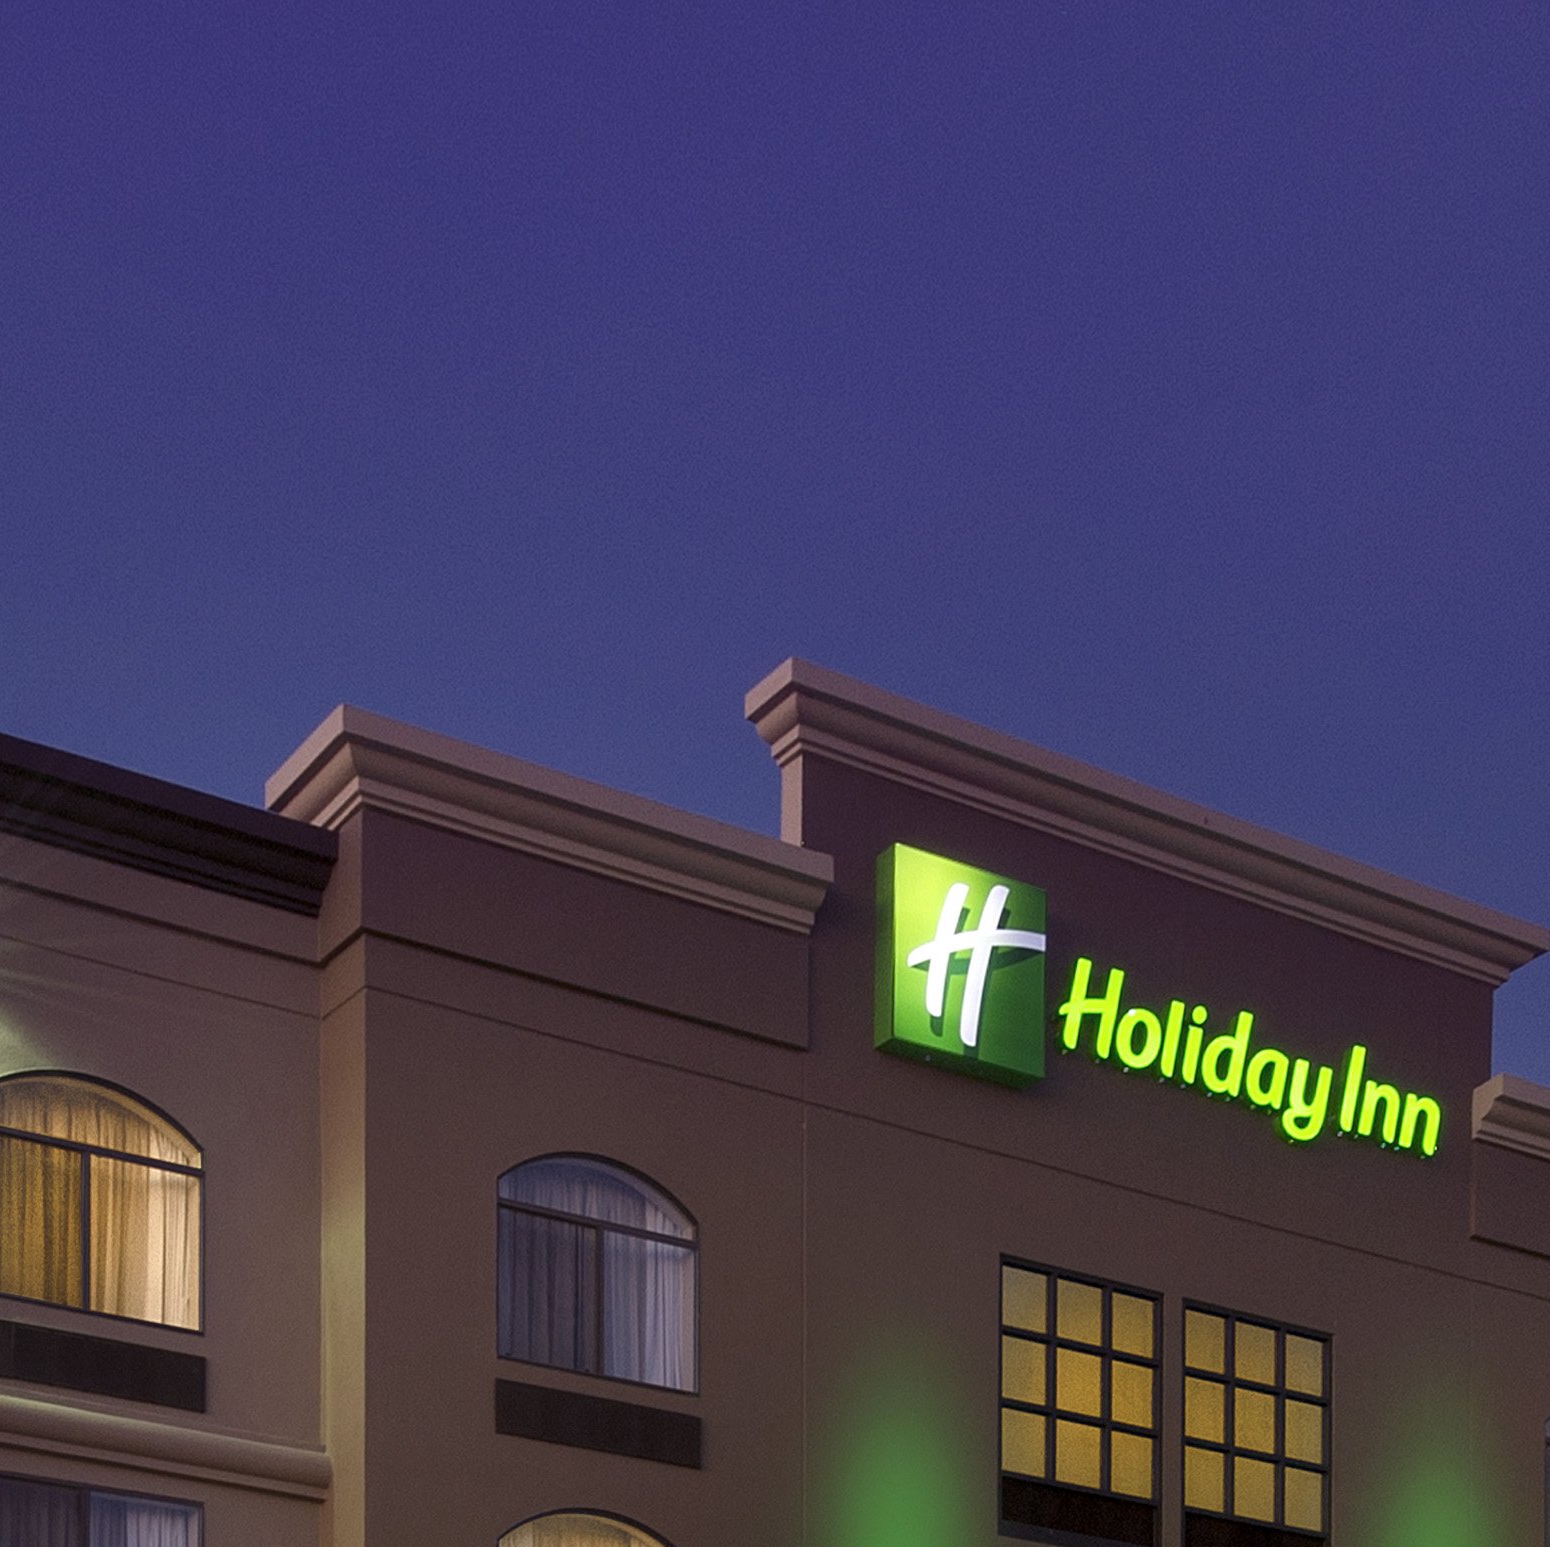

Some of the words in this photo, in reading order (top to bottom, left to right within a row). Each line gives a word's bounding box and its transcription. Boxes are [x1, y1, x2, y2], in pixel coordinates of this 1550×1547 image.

[906, 881, 1047, 1048] H
[1057, 957, 1334, 1141] Holiday
[1338, 1045, 1442, 1157] Inn
